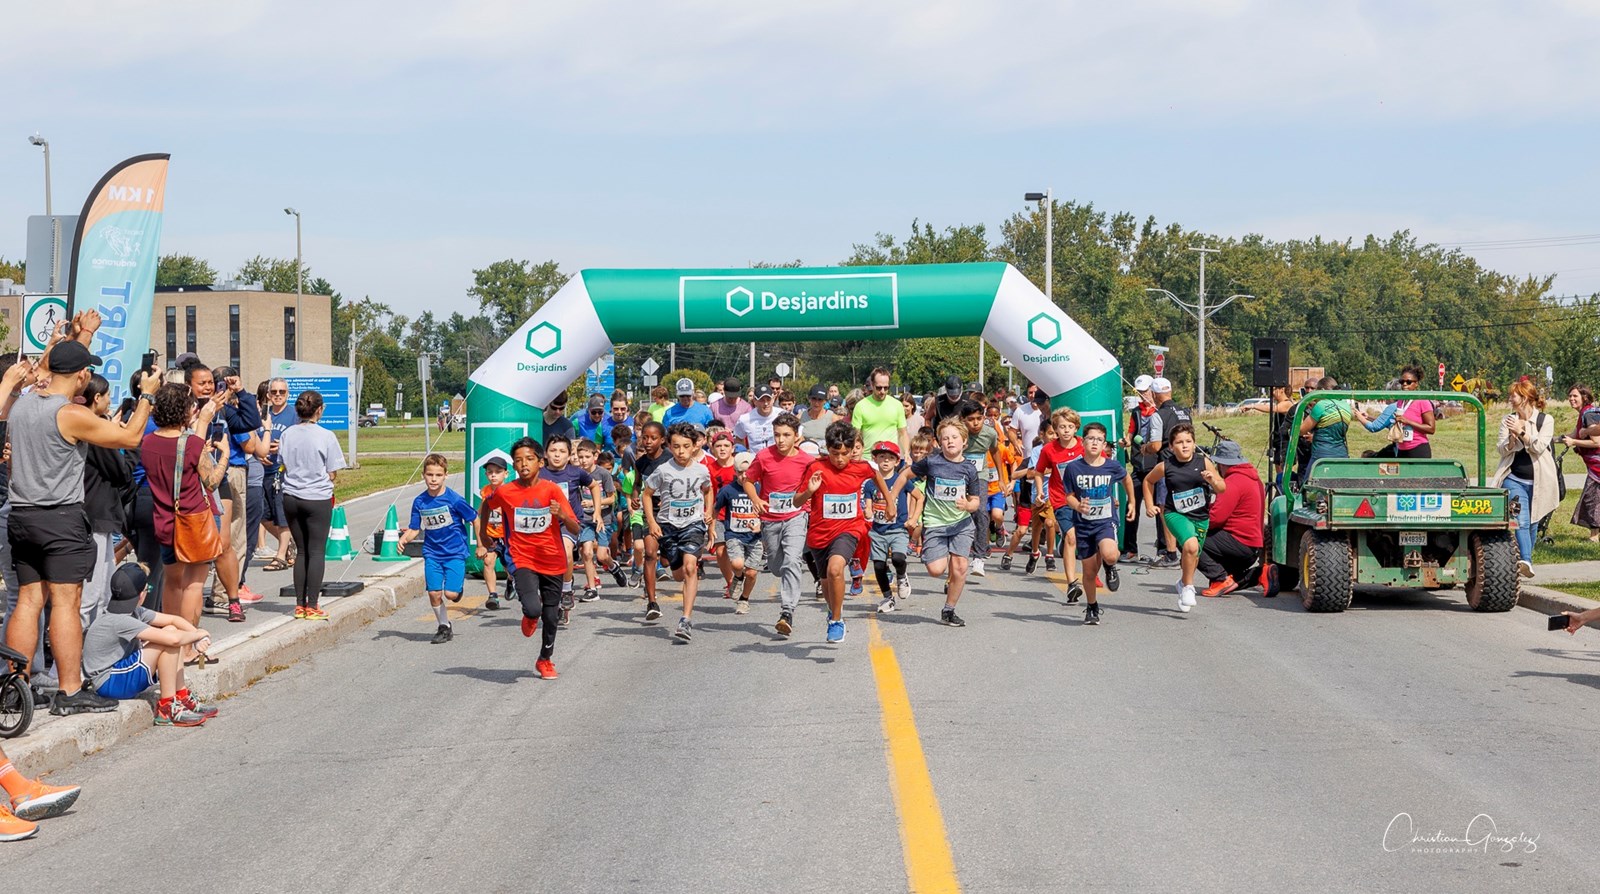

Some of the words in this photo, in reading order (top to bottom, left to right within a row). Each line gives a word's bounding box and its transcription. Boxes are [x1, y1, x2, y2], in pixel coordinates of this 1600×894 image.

[761, 290, 869, 314] Desjardins
[1022, 354, 1070, 364] Desjardins
[516, 362, 568, 373] Desjardins
[1076, 474, 1094, 488] GET
[1095, 474, 1112, 488] OUT
[669, 477, 700, 499] CK
[943, 486, 958, 497] 49
[779, 499, 792, 509] 74
[831, 502, 853, 514] 101
[1180, 494, 1201, 510] 102
[1451, 499, 1492, 508] GATOR
[676, 506, 696, 518] 158
[1089, 506, 1104, 516] 27
[425, 514, 447, 526] 118
[522, 516, 546, 529] 173
